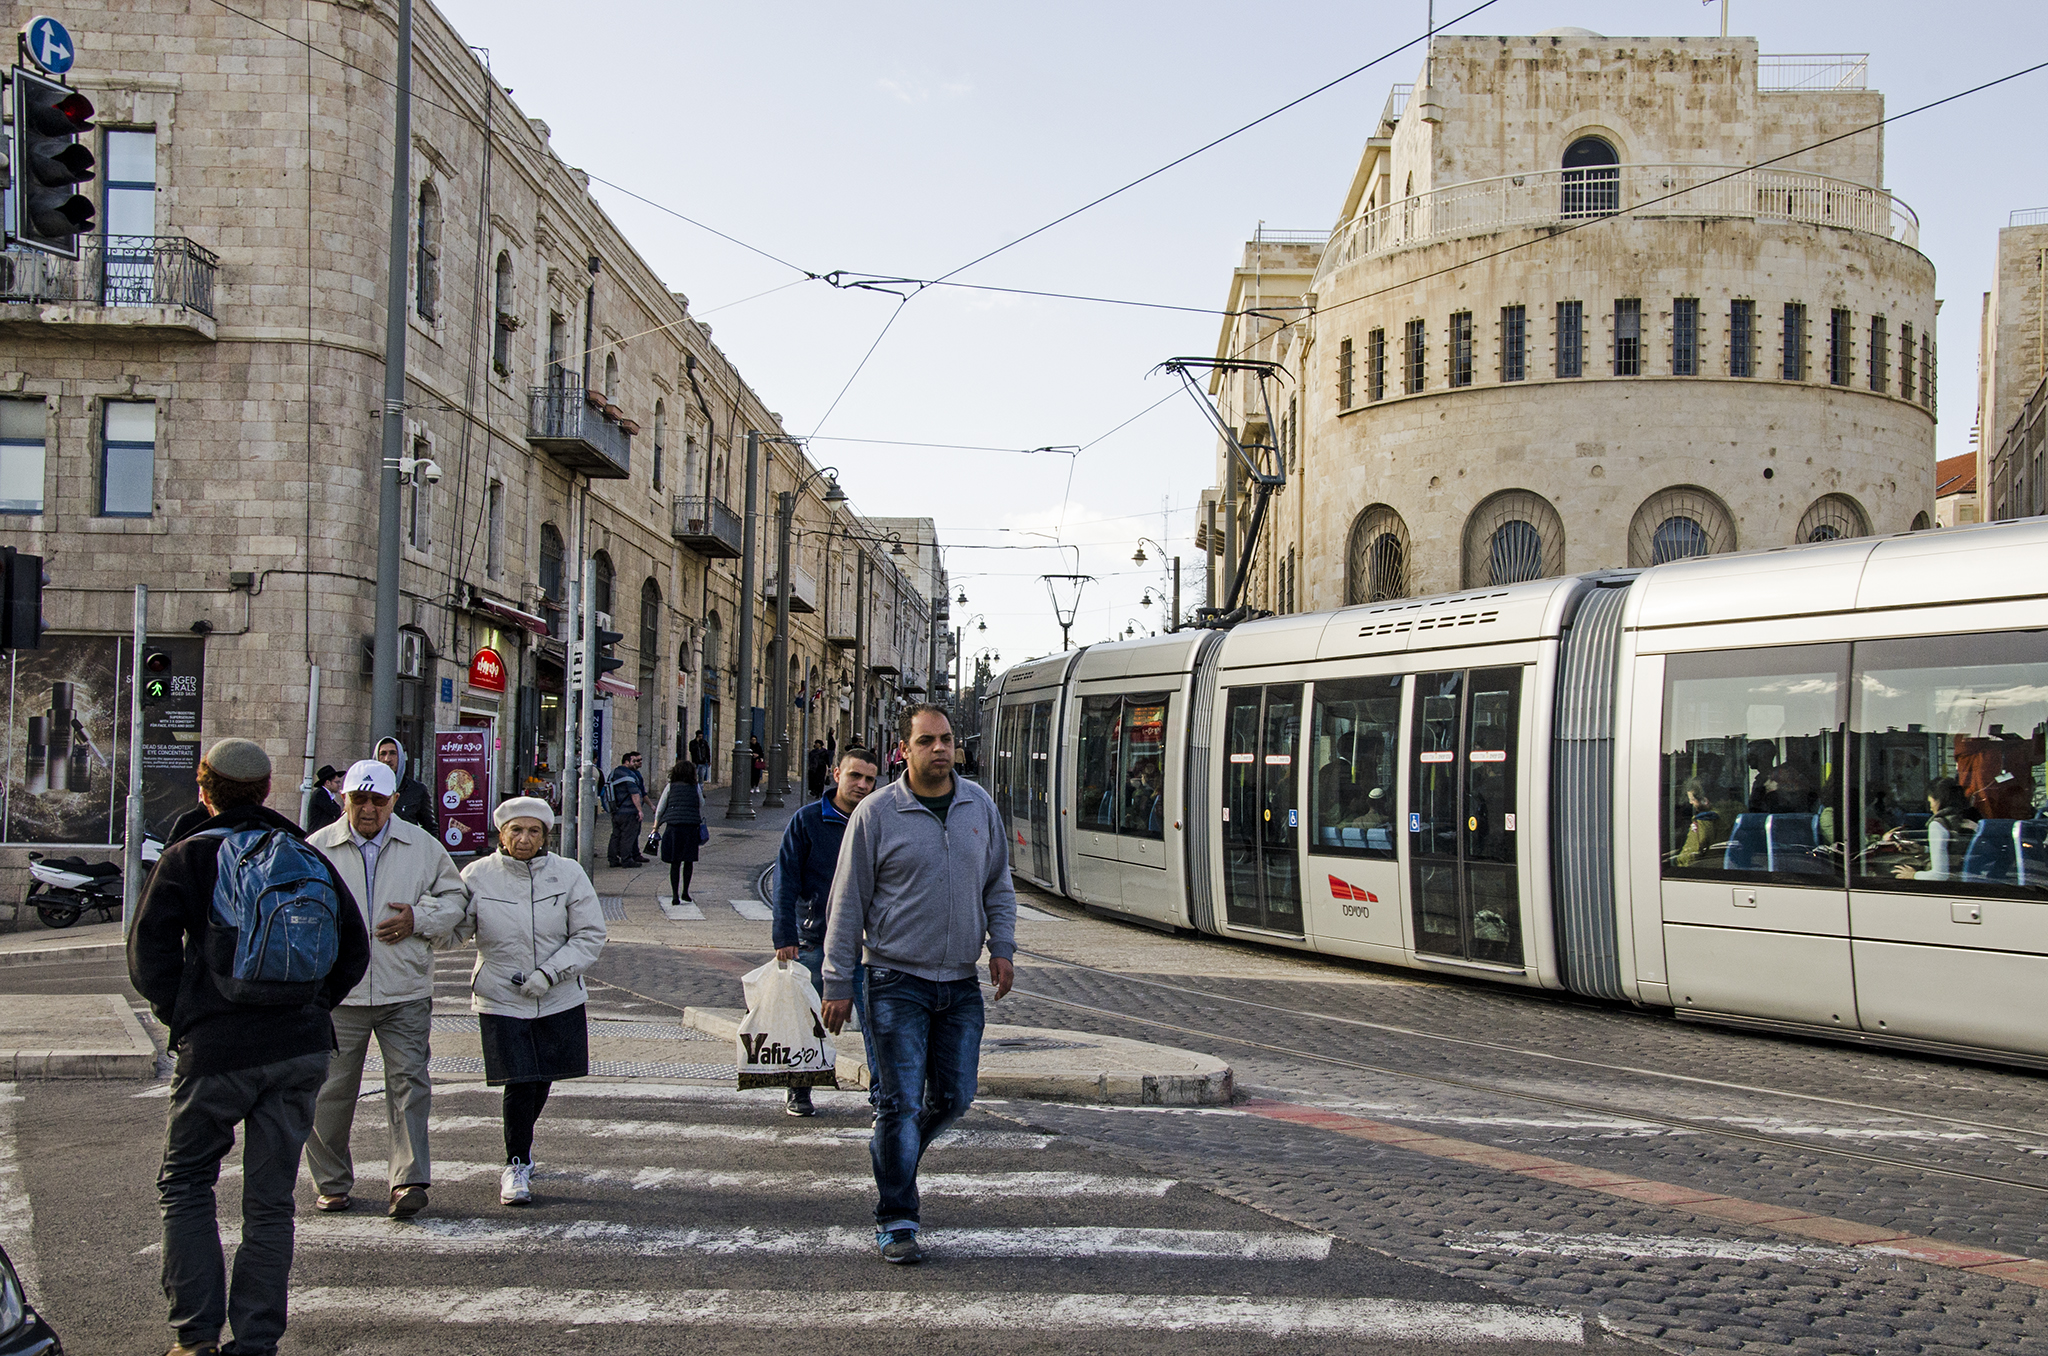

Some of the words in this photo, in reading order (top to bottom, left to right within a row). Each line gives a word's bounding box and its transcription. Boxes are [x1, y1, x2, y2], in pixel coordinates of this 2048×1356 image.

[464, 743, 482, 752] פיצה
[451, 832, 457, 840] 6
[740, 1033, 791, 1064] Yafiz
